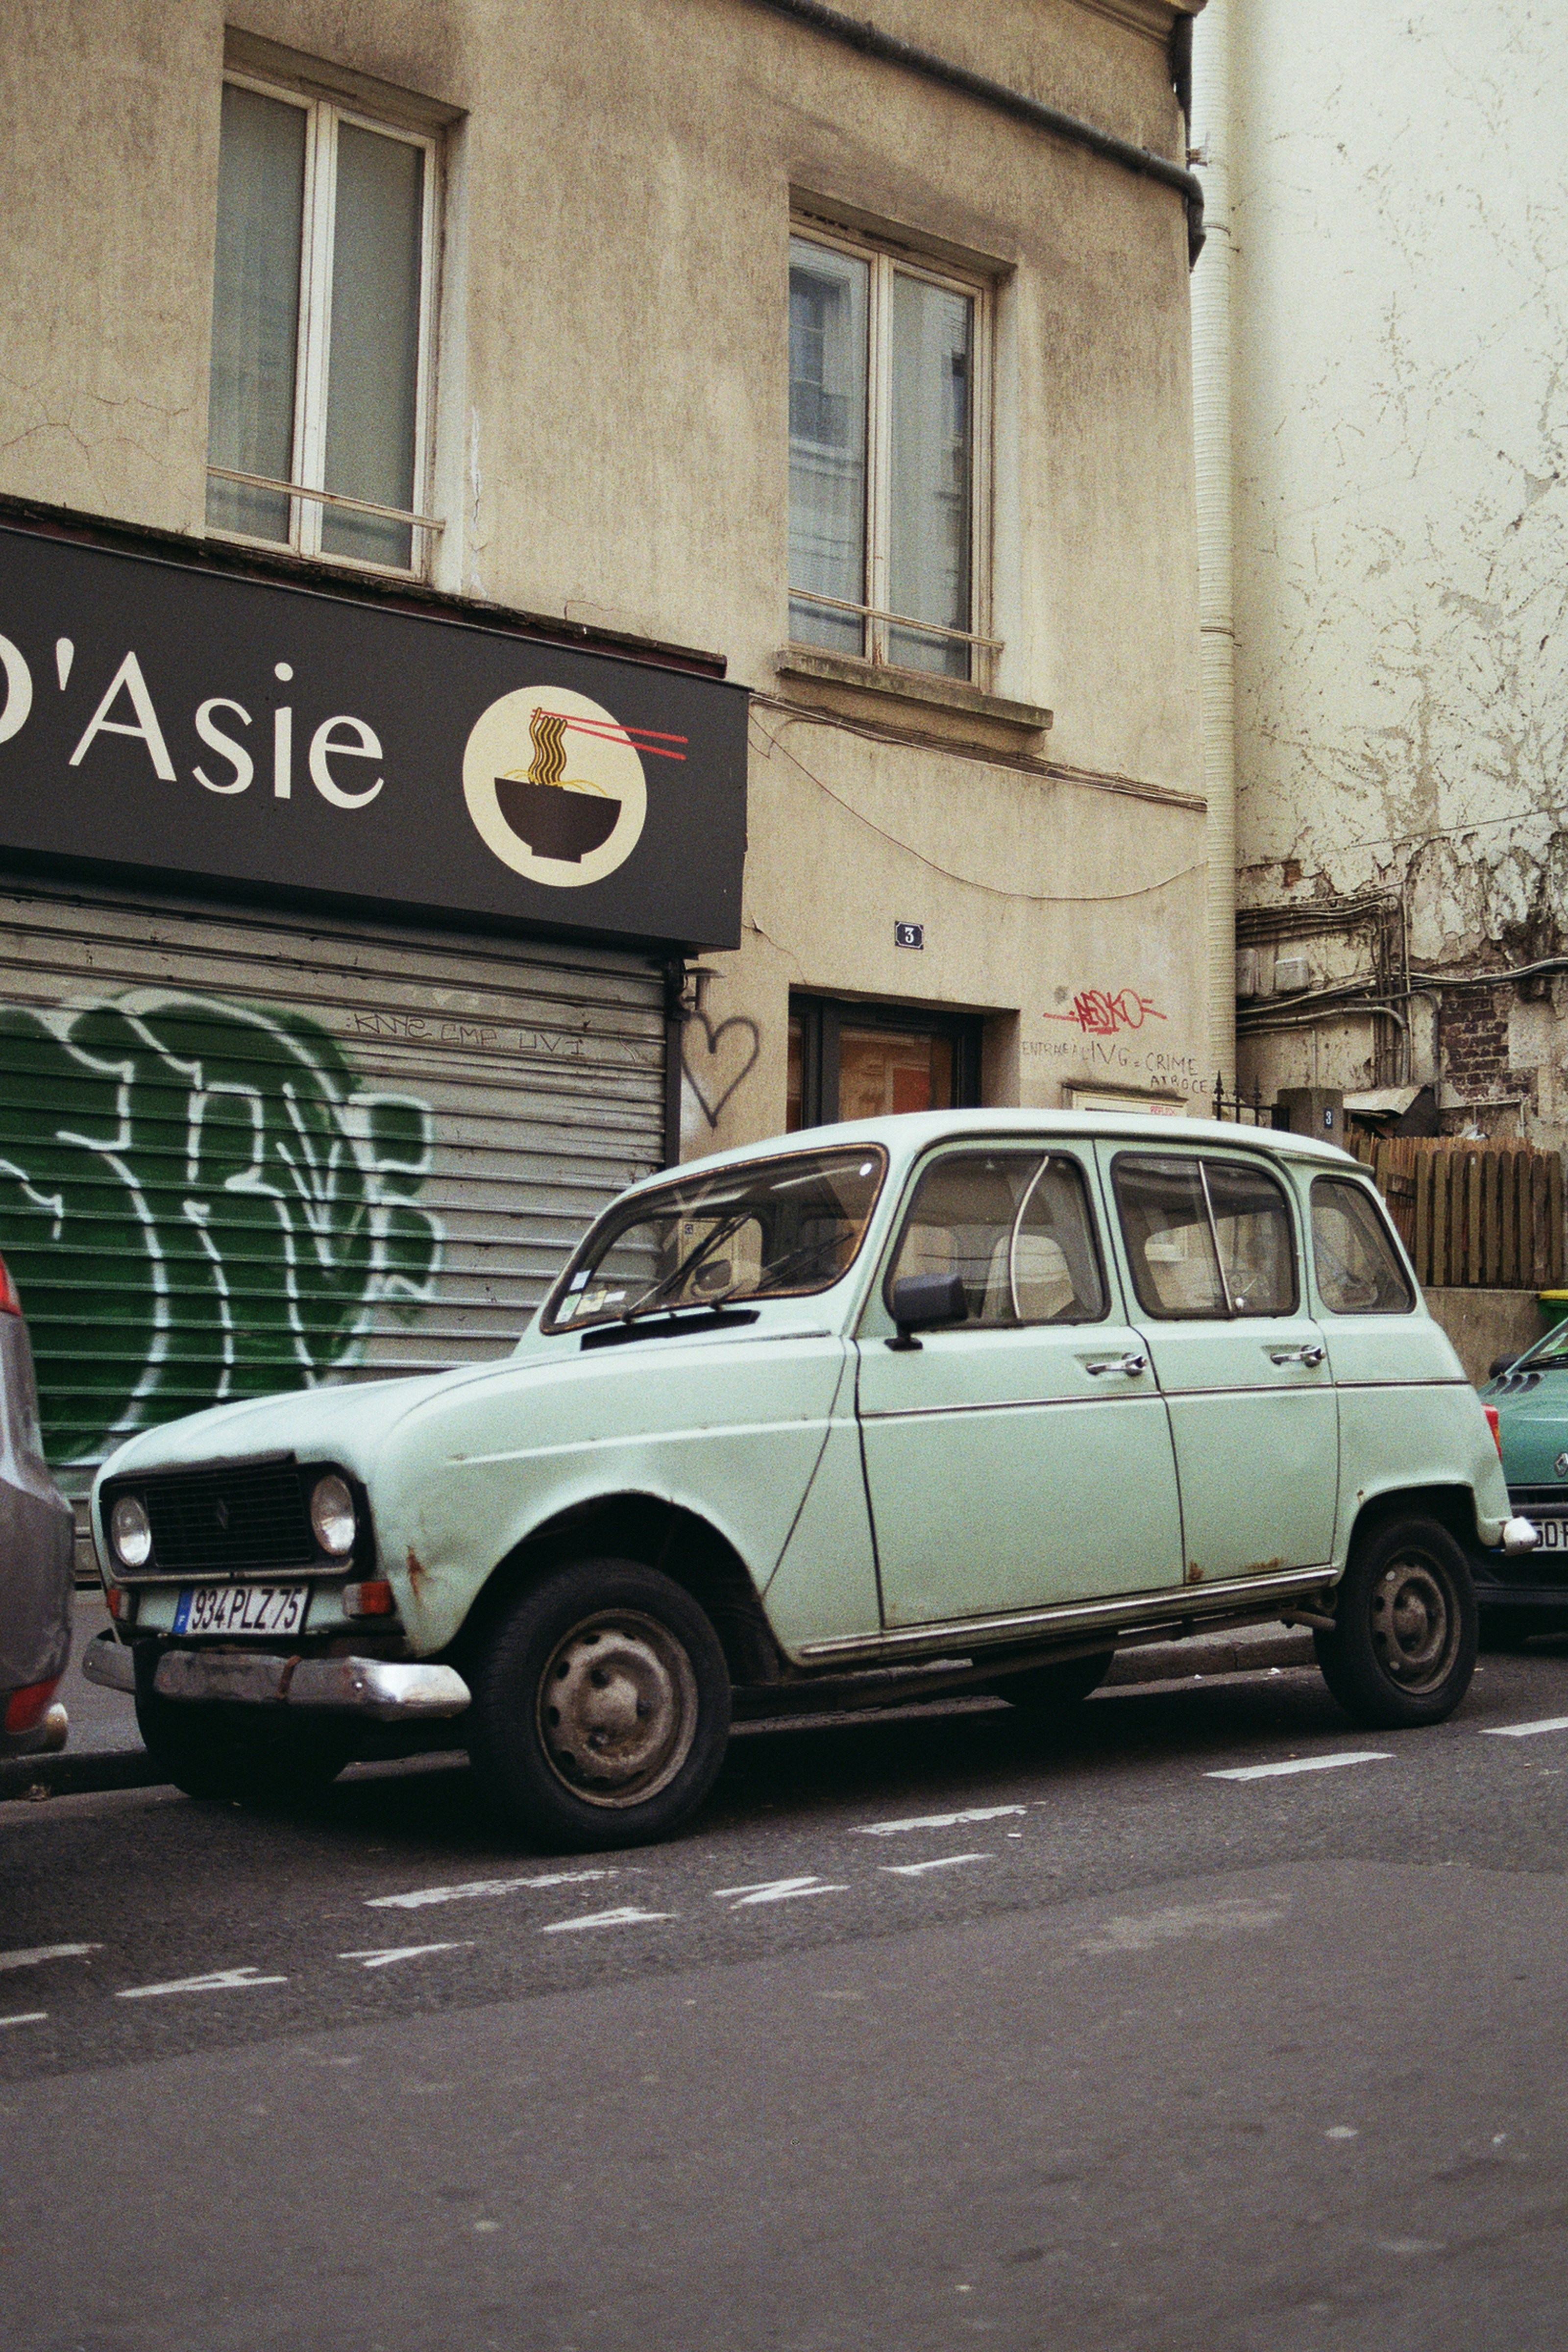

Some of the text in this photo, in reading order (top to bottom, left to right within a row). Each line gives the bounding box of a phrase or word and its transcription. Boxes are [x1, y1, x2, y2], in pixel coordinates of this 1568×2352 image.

[905, 927, 914, 943] 3
[1146, 1053, 1199, 1076] CRIME
[1151, 1075, 1208, 1094] ATROCE
[1325, 1111, 1331, 1125] 3
[178, 1587, 303, 1630] F 934 PLZ 75
